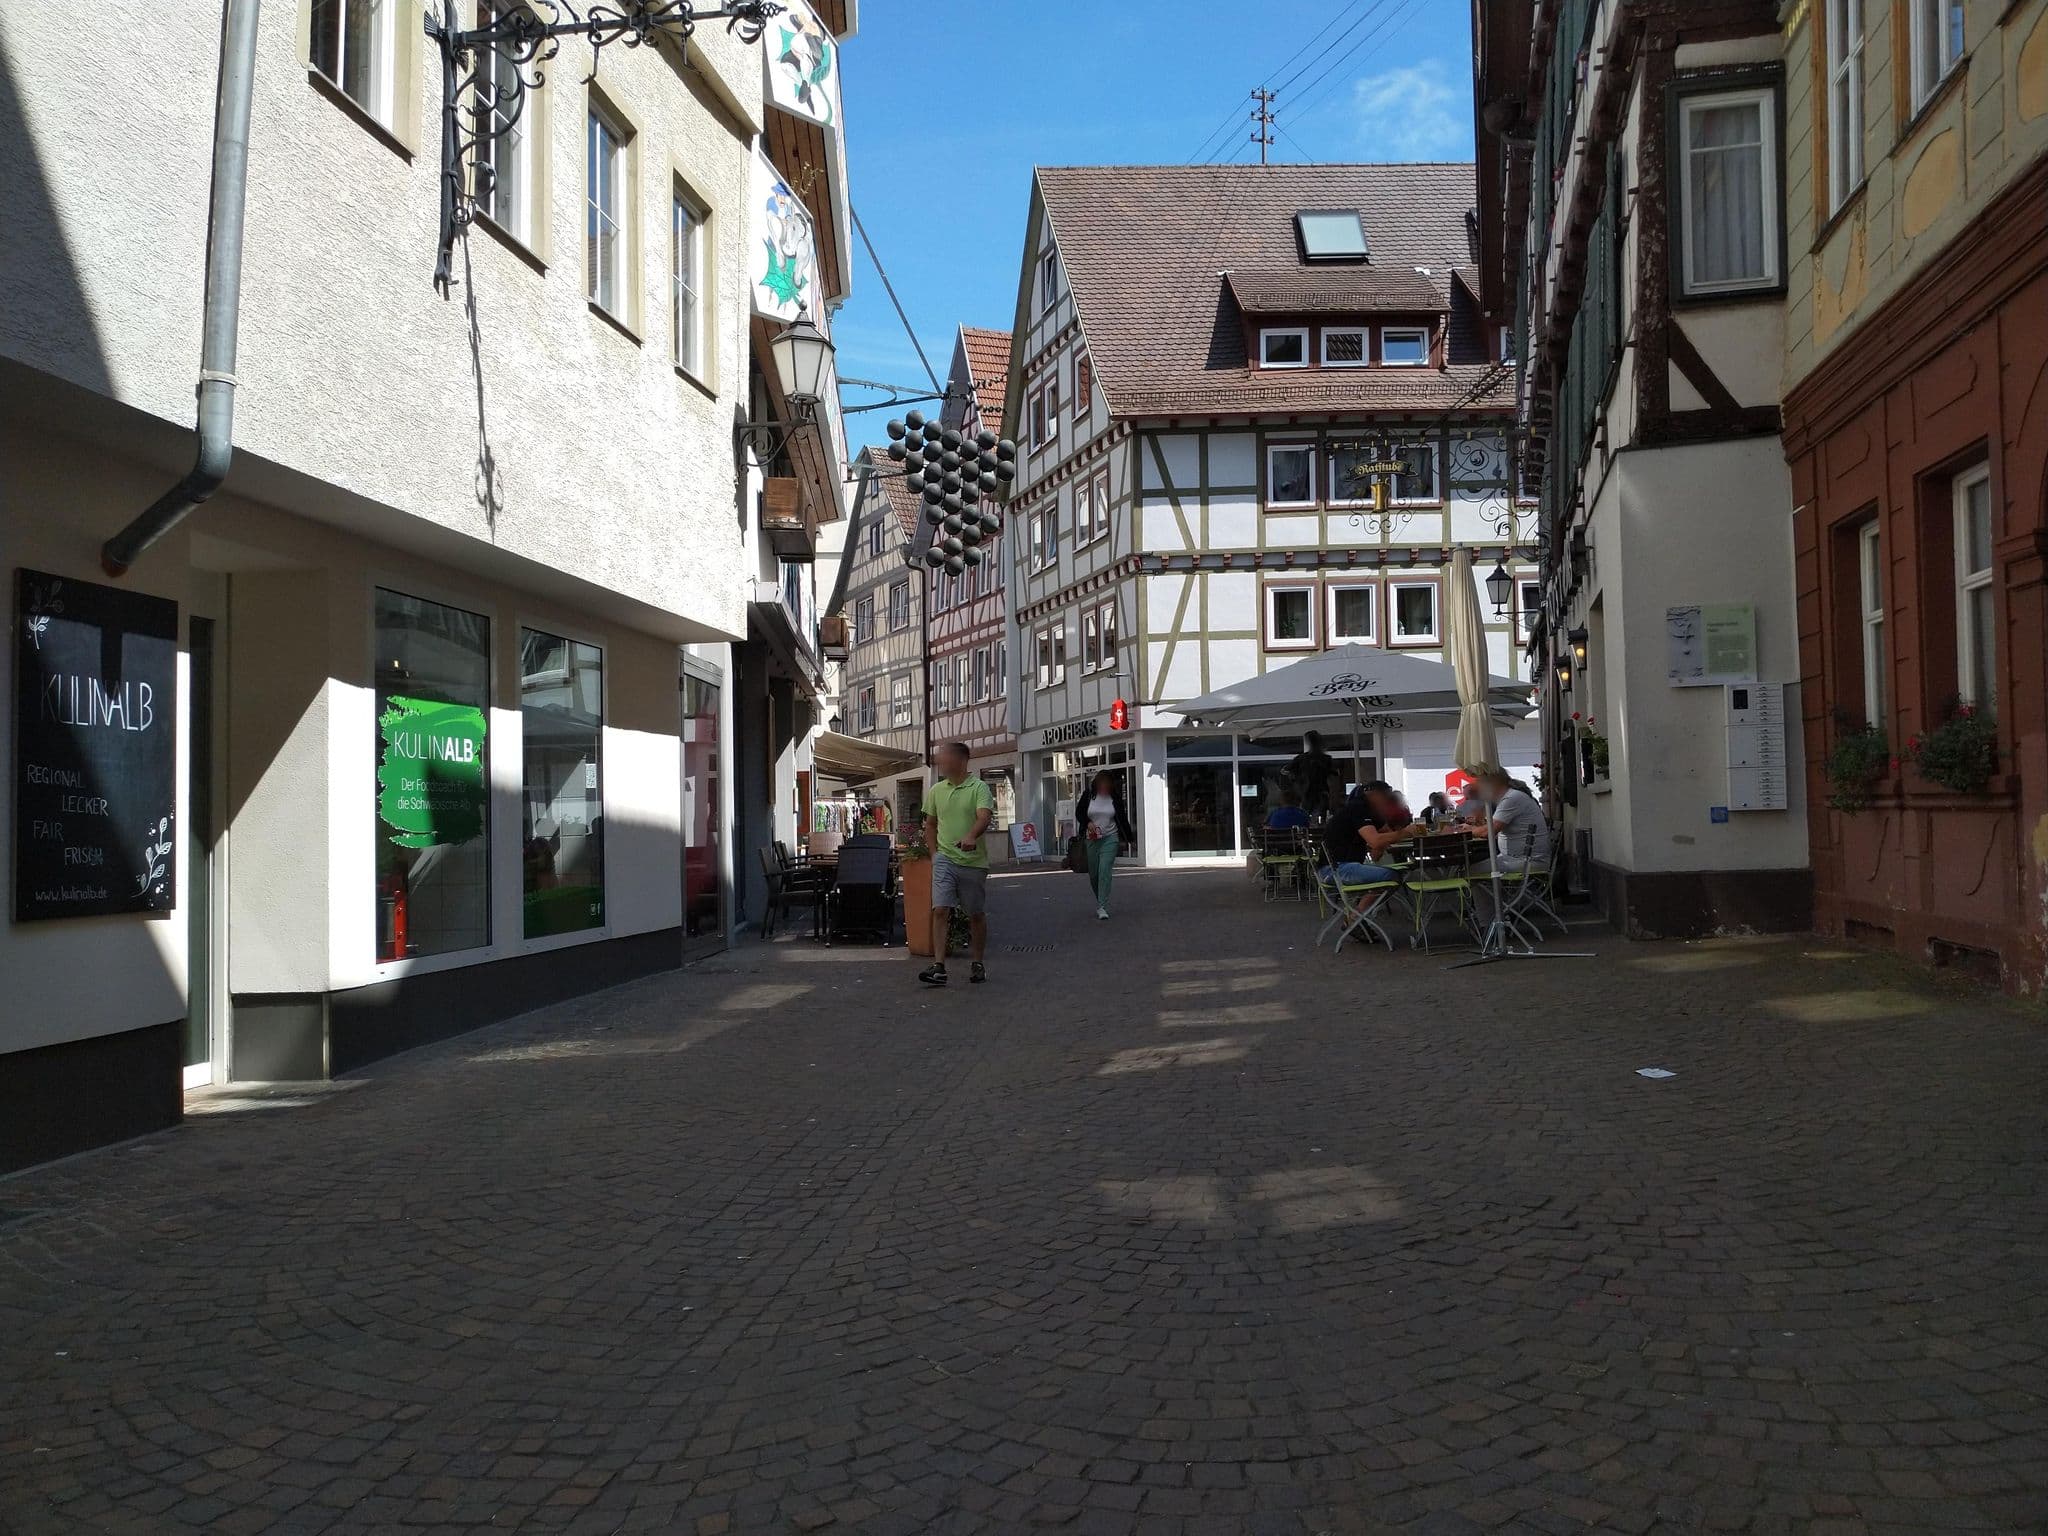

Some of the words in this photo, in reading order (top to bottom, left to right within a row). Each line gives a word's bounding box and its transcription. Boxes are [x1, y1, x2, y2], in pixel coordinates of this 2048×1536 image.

[1309, 679, 1377, 697] Berg
[40, 673, 153, 731] KULINALB
[1042, 719, 1099, 745] APOTHEKE
[394, 731, 474, 763] KULINALB
[26, 763, 85, 790] REGIONAL
[401, 777, 414, 791] Der
[62, 795, 109, 817] LECKER
[397, 796, 410, 810] die
[33, 818, 64, 841] FAIR
